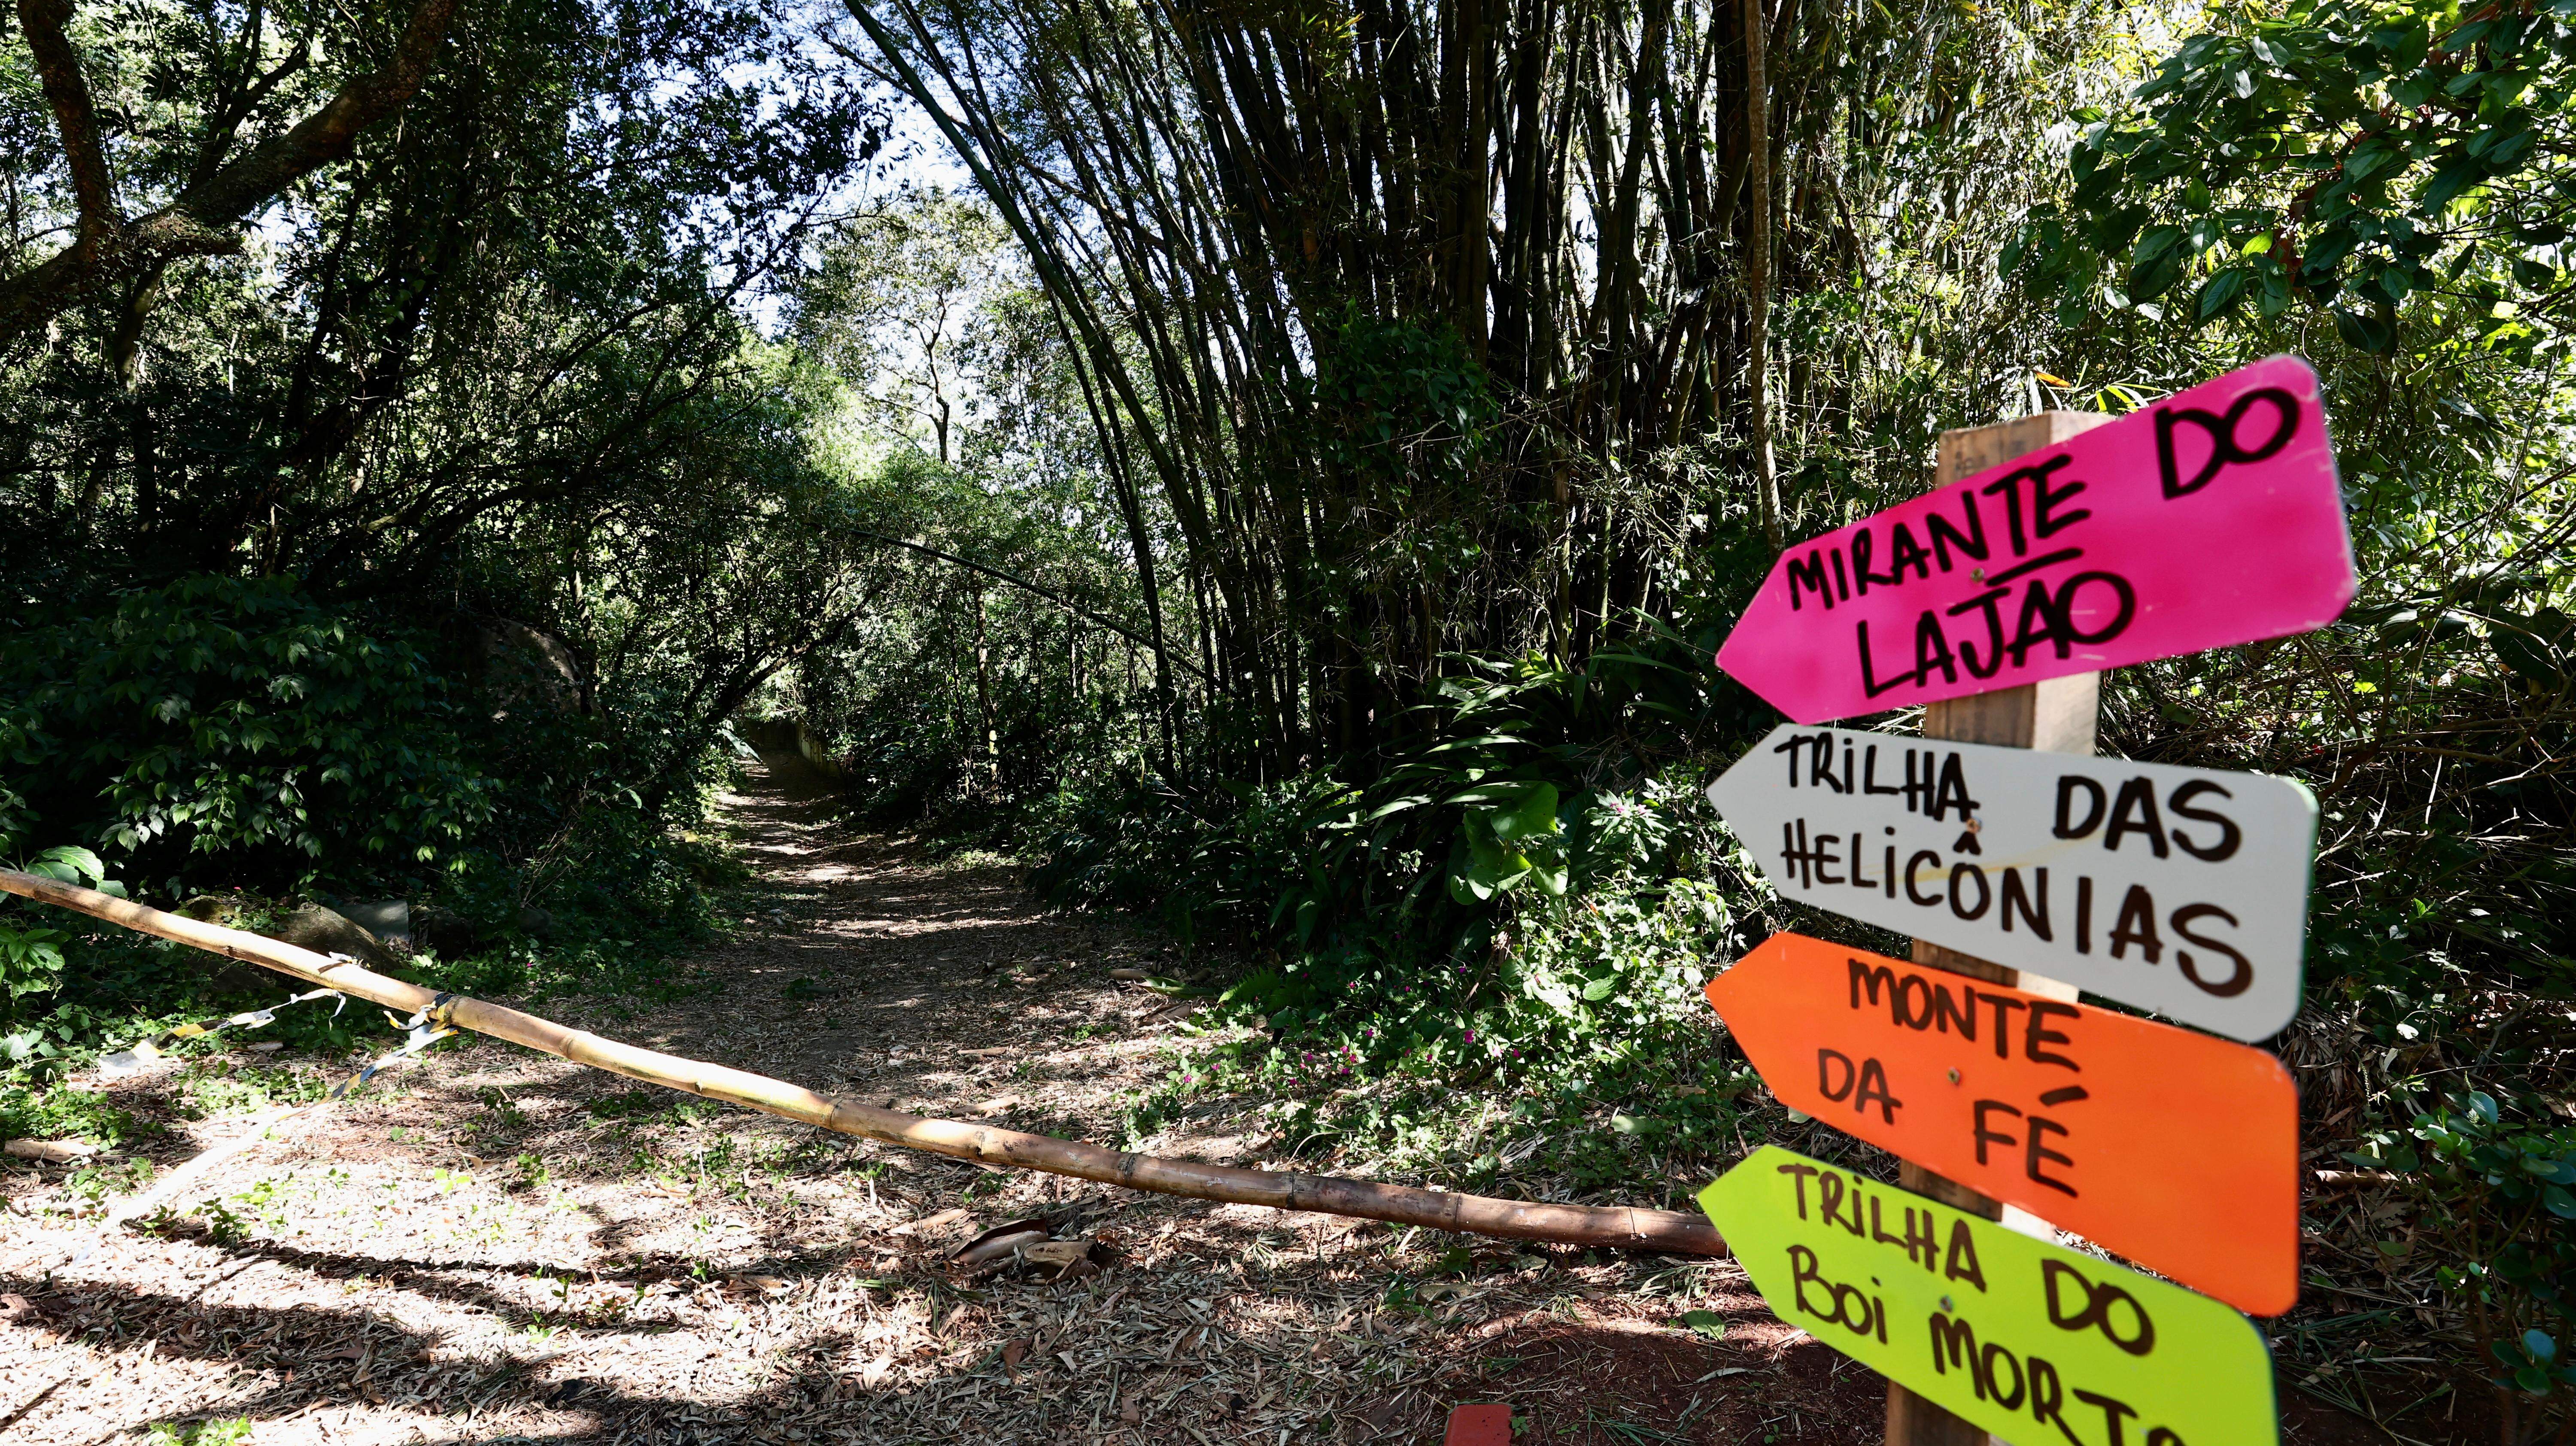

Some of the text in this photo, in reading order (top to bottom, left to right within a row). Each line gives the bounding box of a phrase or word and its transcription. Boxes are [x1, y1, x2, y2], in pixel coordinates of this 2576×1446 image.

[1786, 387, 2301, 611] MIRANTE DO
[2051, 775, 2242, 860] DAS
[1848, 958, 2081, 1072] MONTE
[1819, 1049, 2088, 1198] DA FÉ
[2041, 1258, 2156, 1357] DO
